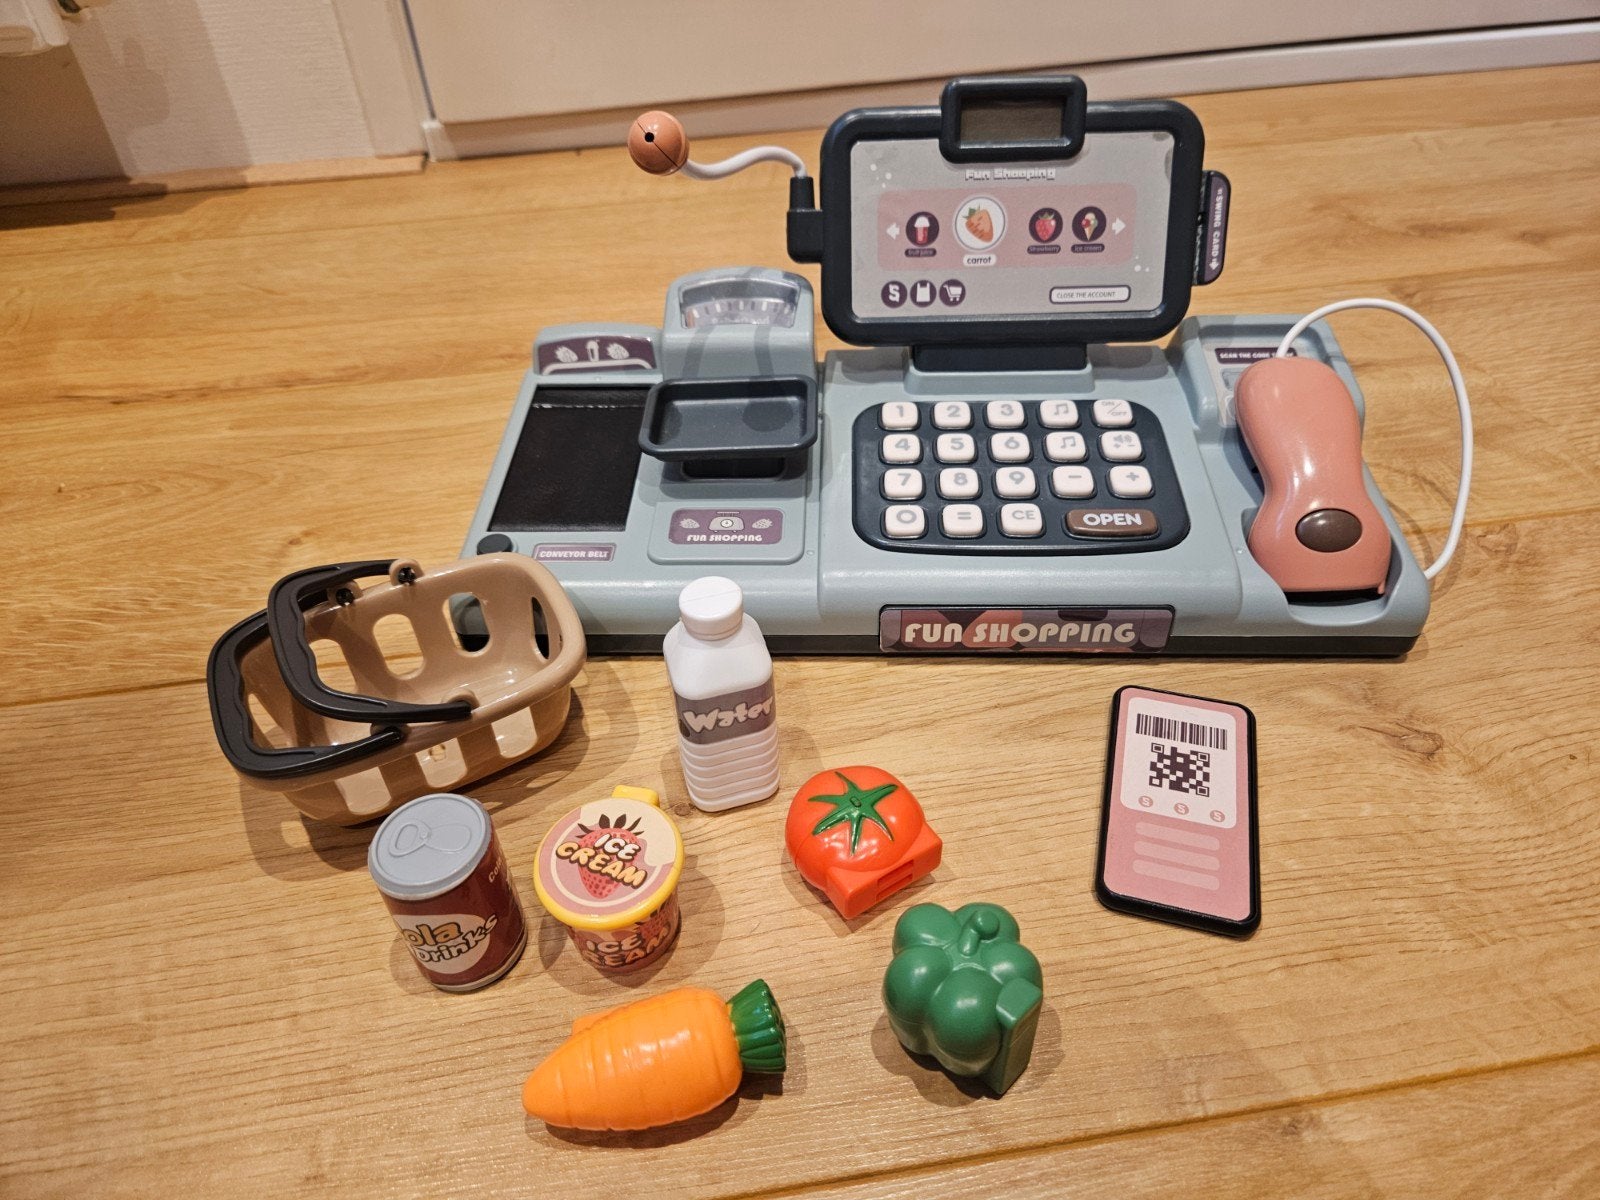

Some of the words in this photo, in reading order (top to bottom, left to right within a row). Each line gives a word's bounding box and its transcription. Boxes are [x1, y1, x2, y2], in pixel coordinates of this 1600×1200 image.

[965, 168, 991, 180] Fun
[1213, 195, 1224, 228] SWING
[1211, 230, 1220, 257] CARD
[966, 256, 992, 265] carrot
[896, 405, 904, 417] 1
[946, 405, 961, 418] 2
[1001, 404, 1014, 417] 3
[894, 438, 911, 451] 4
[950, 438, 964, 451] 5
[1004, 437, 1021, 450] 6
[897, 473, 912, 487] 7
[953, 473, 968, 486] 8
[1008, 472, 1025, 486] 9
[1012, 510, 1036, 520] CE
[1082, 512, 1143, 527] OPEN
[709, 534, 763, 543] SHOPPING
[540, 550, 586, 558] CONVEYOR
[588, 550, 609, 558] BELT
[904, 623, 963, 643] FUN
[973, 622, 1136, 643] SHOPPING
[682, 696, 774, 733] Water
[593, 833, 642, 862] ICE
[555, 841, 648, 890] CREAM
[402, 922, 463, 947] ola
[582, 925, 671, 968] REAM
[586, 932, 643, 954] ICE
